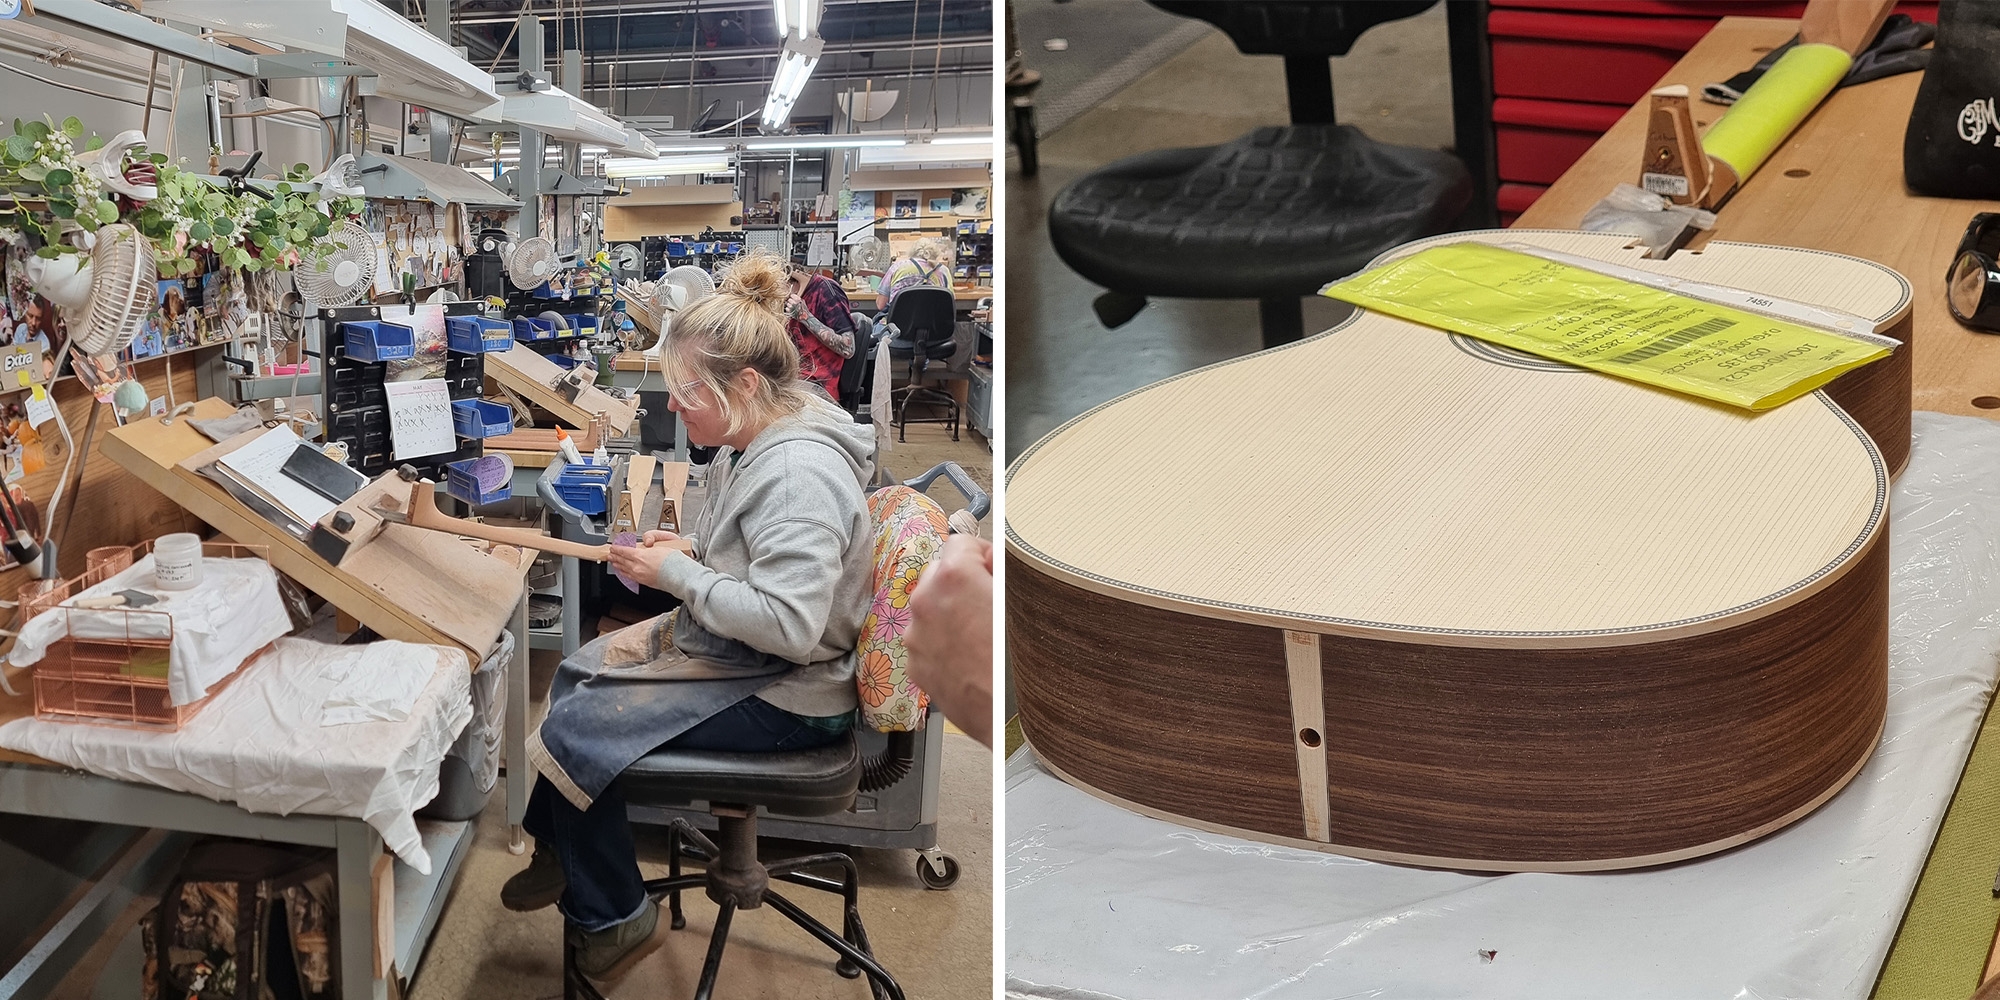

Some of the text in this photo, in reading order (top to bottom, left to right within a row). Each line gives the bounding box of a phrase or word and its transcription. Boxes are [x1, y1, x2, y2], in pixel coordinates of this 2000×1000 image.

[1745, 296, 1773, 307] 74551
[1670, 307, 1705, 320] Serial
[1560, 323, 1628, 350] KUROSAWA
[1619, 319, 1672, 339] Number:
[386, 346, 403, 356] 320
[1717, 347, 1771, 369] 052135
[5, 352, 33, 371] Extra
